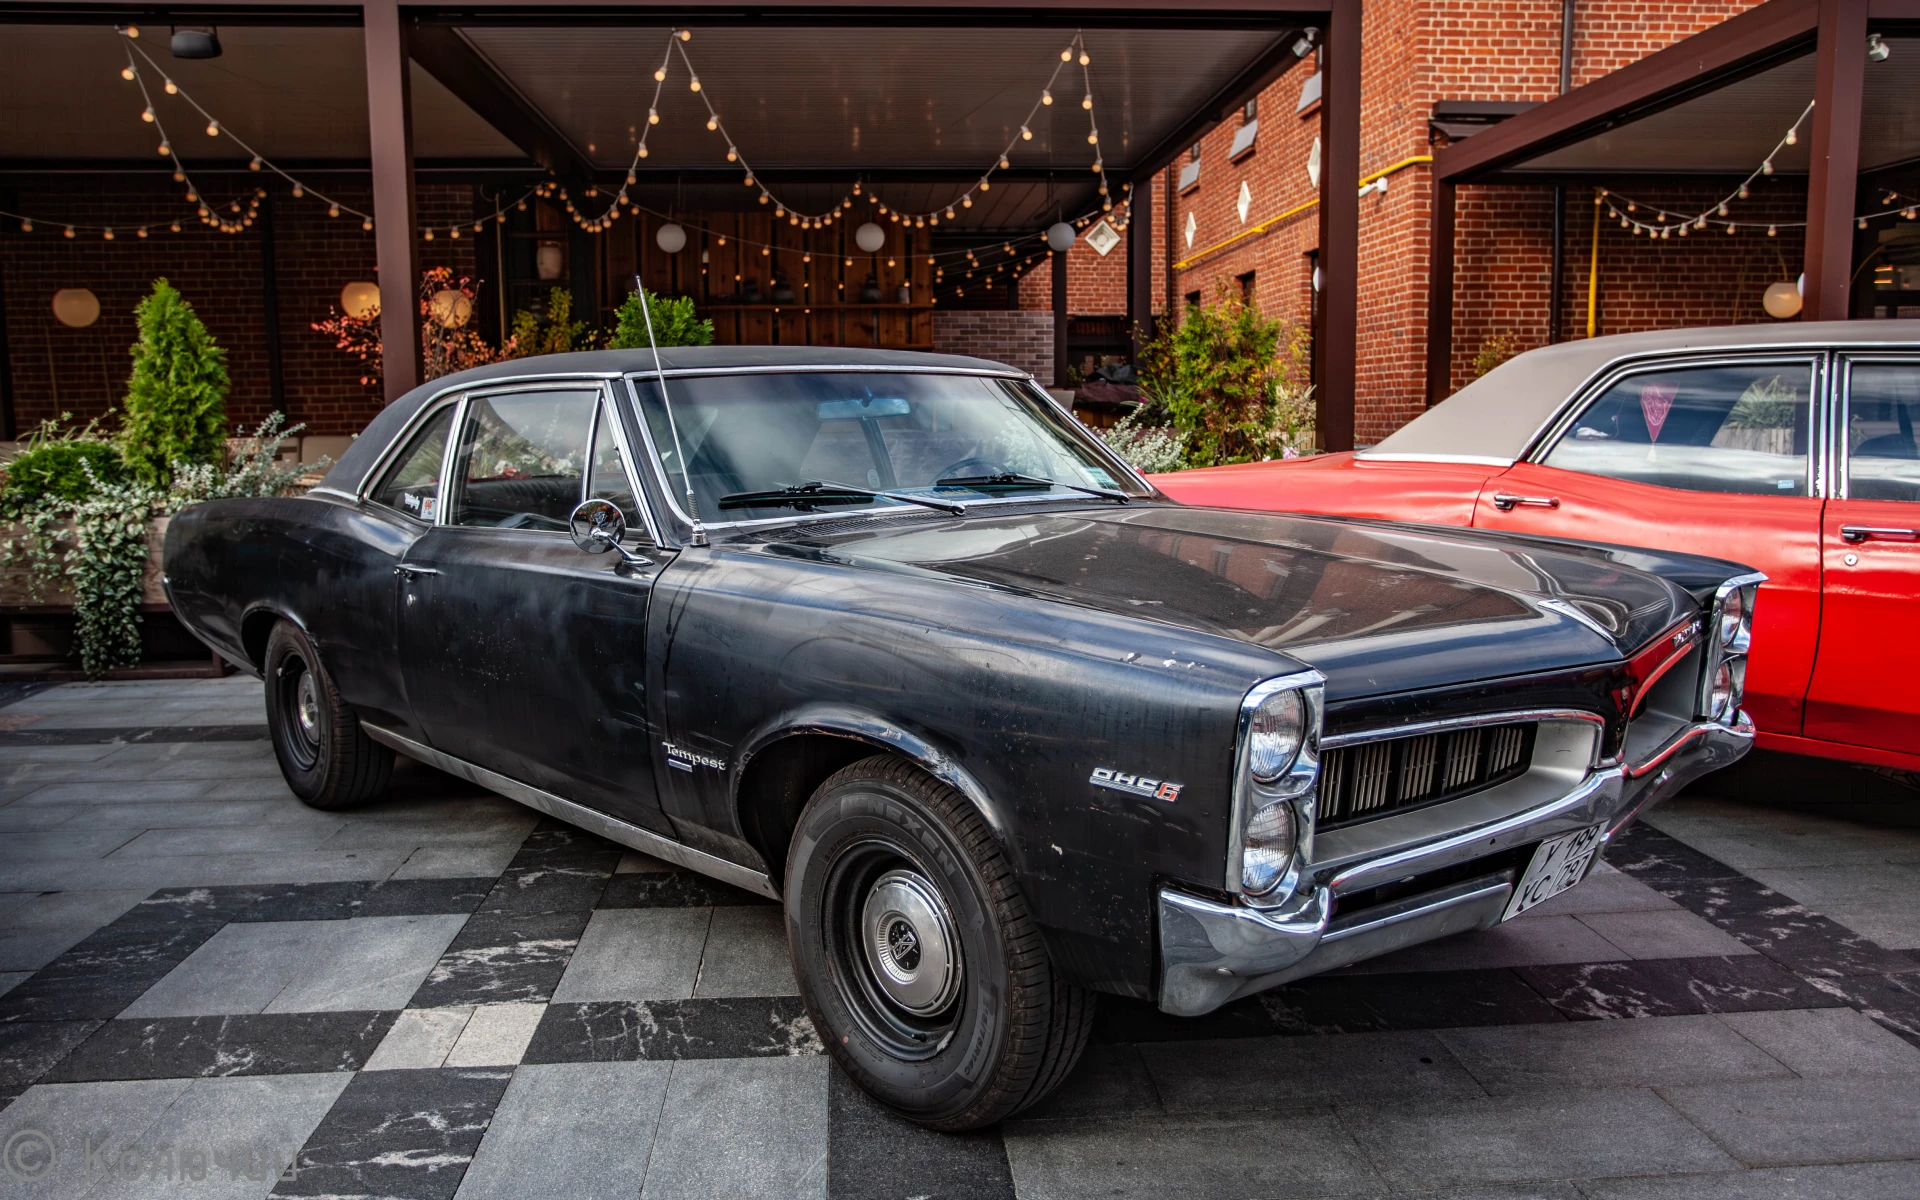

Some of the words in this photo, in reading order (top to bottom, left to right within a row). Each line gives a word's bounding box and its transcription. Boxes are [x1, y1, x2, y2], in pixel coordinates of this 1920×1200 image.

[662, 741, 726, 771] Tempest
[867, 798, 956, 877] NEXEN
[1564, 825, 1600, 861] 199
[1556, 854, 1591, 886] 797
